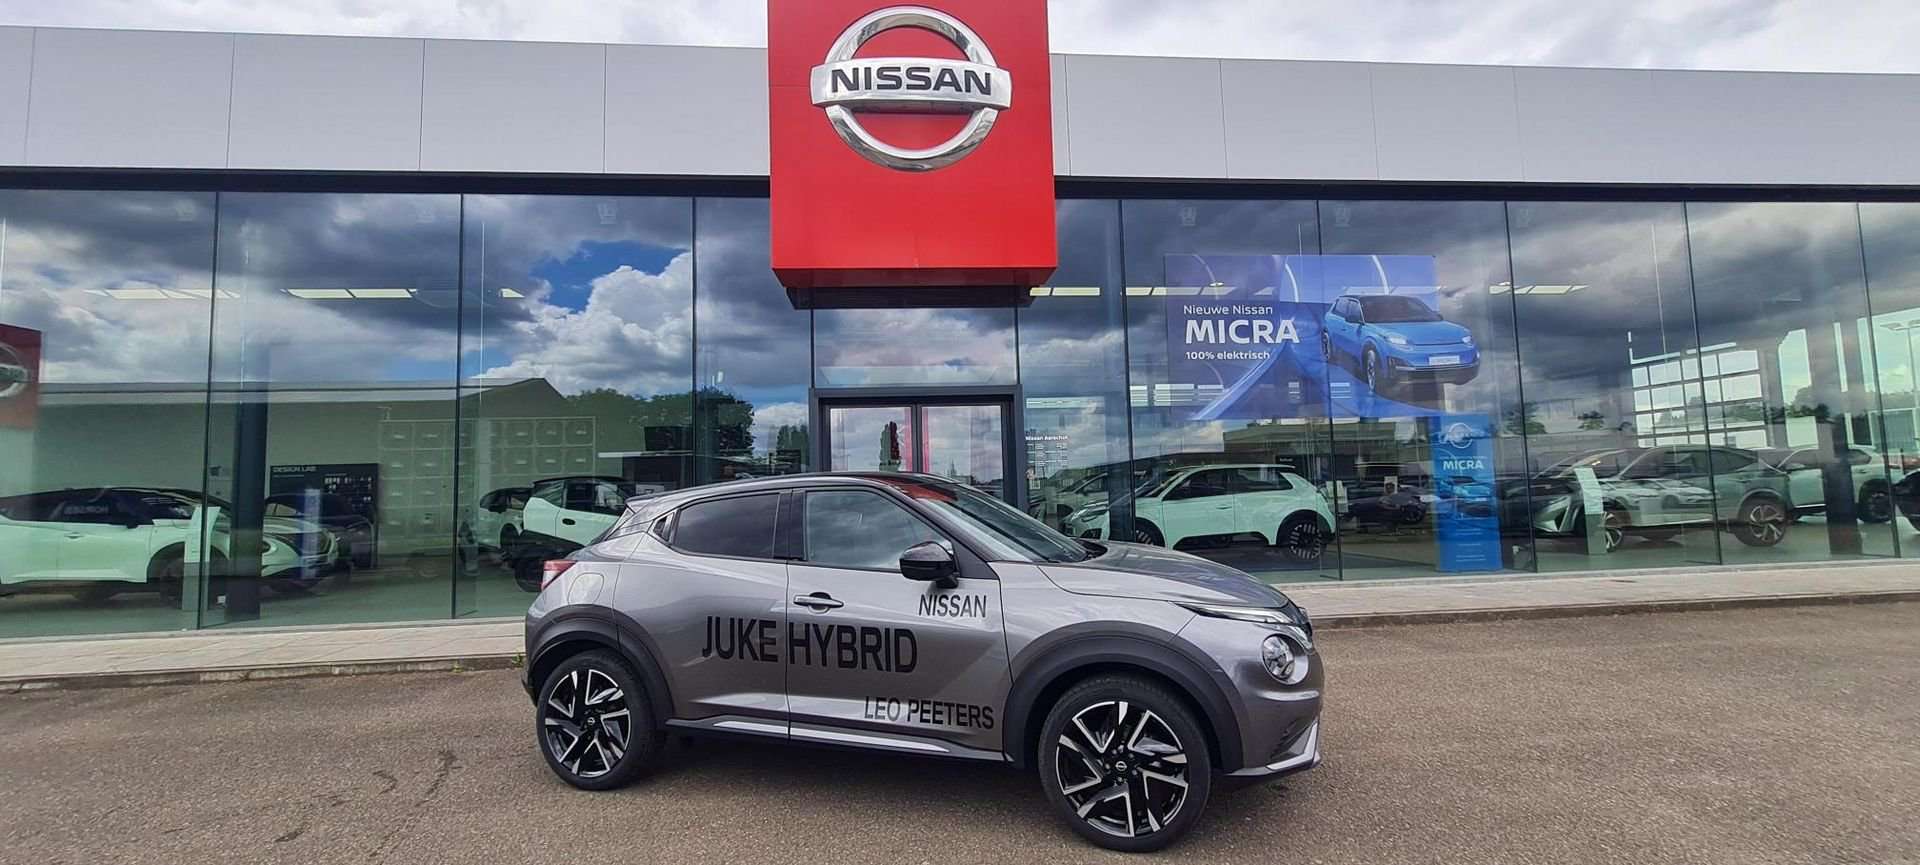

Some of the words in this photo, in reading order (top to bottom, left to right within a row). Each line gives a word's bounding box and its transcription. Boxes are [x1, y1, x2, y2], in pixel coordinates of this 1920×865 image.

[831, 66, 992, 96] NISSAN
[1183, 304, 1230, 315] Nieuwe
[1232, 304, 1273, 315] Nissan
[1185, 319, 1300, 344] MICRA
[1185, 351, 1215, 360] 100%
[1217, 351, 1271, 360] elektrisch
[1443, 460, 1485, 471] MICRA
[918, 594, 987, 618] NISSAN
[702, 616, 778, 663] JUKE
[789, 622, 918, 673] HYBRID
[864, 696, 901, 721] LEO
[907, 699, 994, 730] PEETERS
